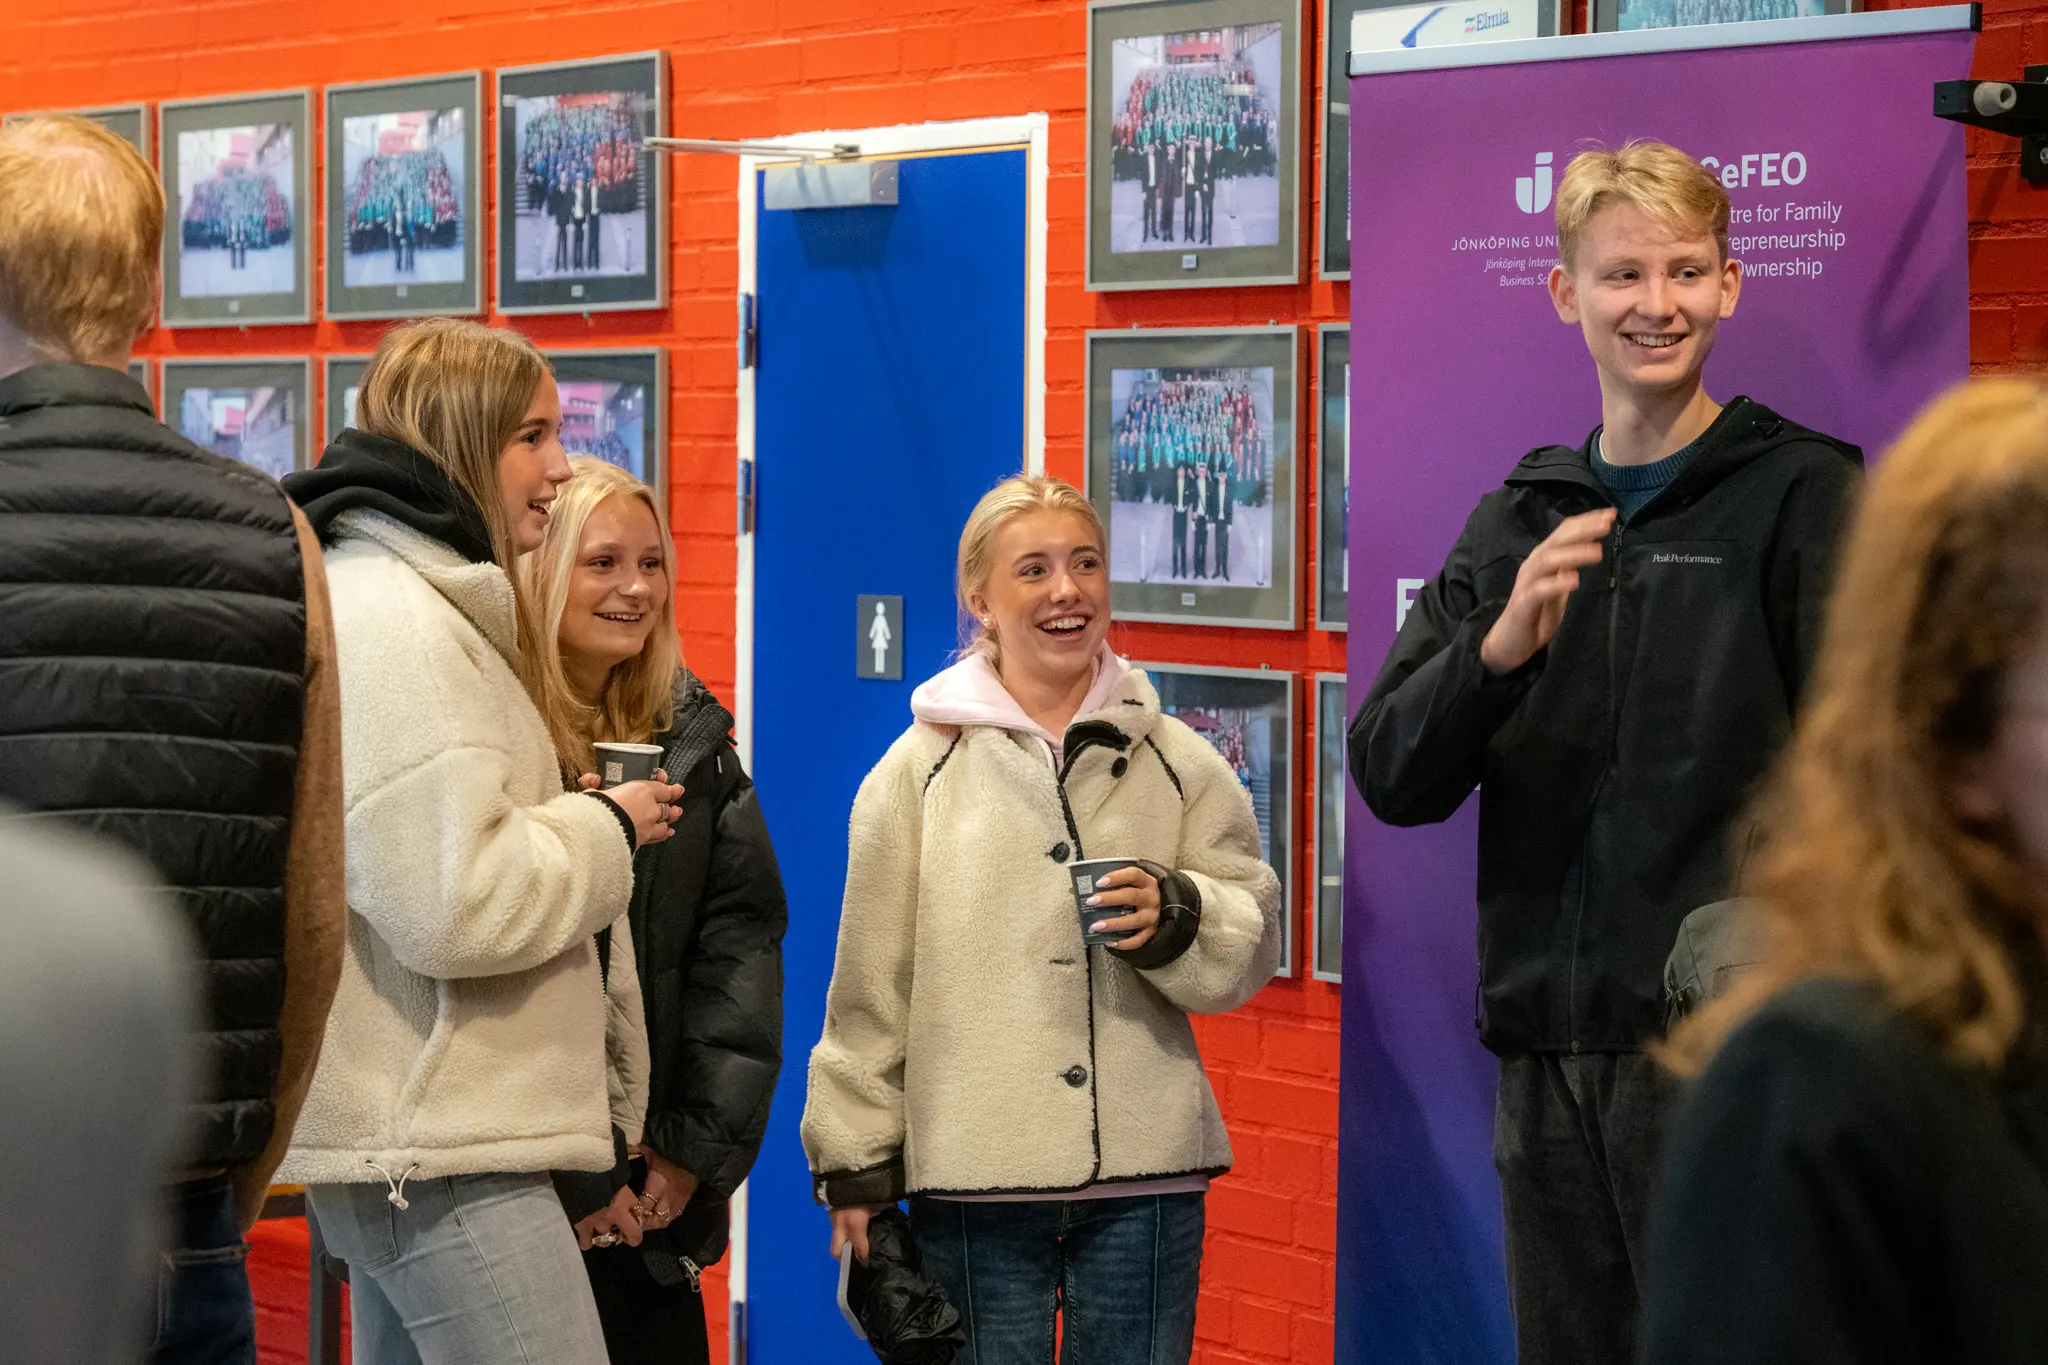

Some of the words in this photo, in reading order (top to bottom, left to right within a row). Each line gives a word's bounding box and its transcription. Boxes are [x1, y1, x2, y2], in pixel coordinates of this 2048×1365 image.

[1476, 9, 1510, 31] Elmia
[1730, 206, 1752, 223] tre
[1756, 204, 1780, 222] for
[1785, 201, 1842, 223] Family
[1451, 235, 1530, 251] JÖNKÖPING
[1535, 235, 1559, 247] UNI
[1483, 257, 1525, 272] Jönköping
[1528, 256, 1560, 268] Interna
[1500, 274, 1534, 286] Business
[1537, 273, 1549, 285] Sc
